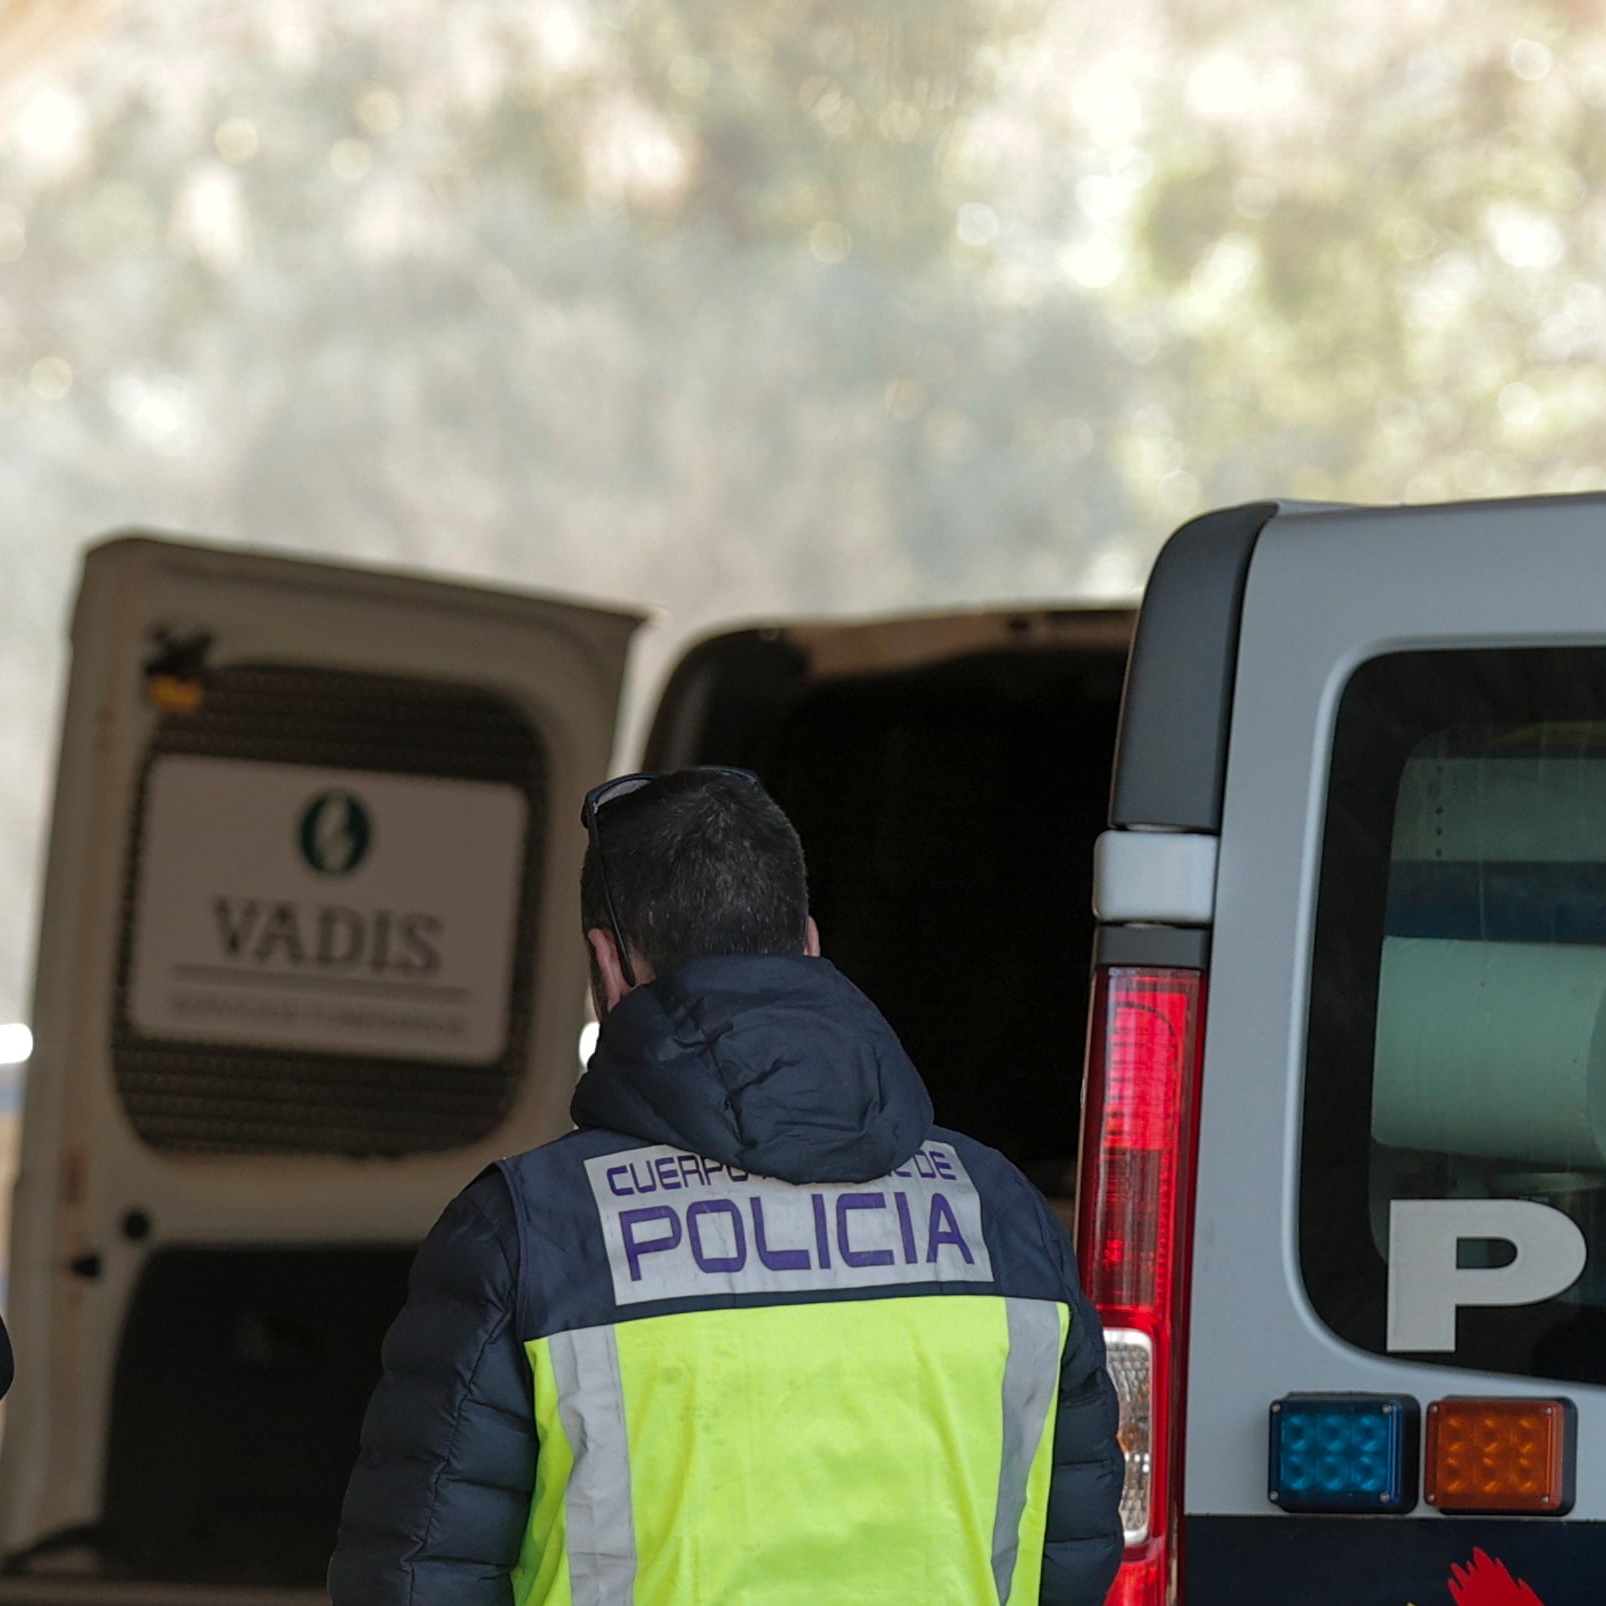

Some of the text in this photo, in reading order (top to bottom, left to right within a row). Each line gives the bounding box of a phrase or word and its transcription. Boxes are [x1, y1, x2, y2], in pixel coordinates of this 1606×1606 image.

[214, 896, 442, 975] VADIS
[912, 1148, 958, 1181] DE
[618, 1191, 975, 1282] POLICIA
